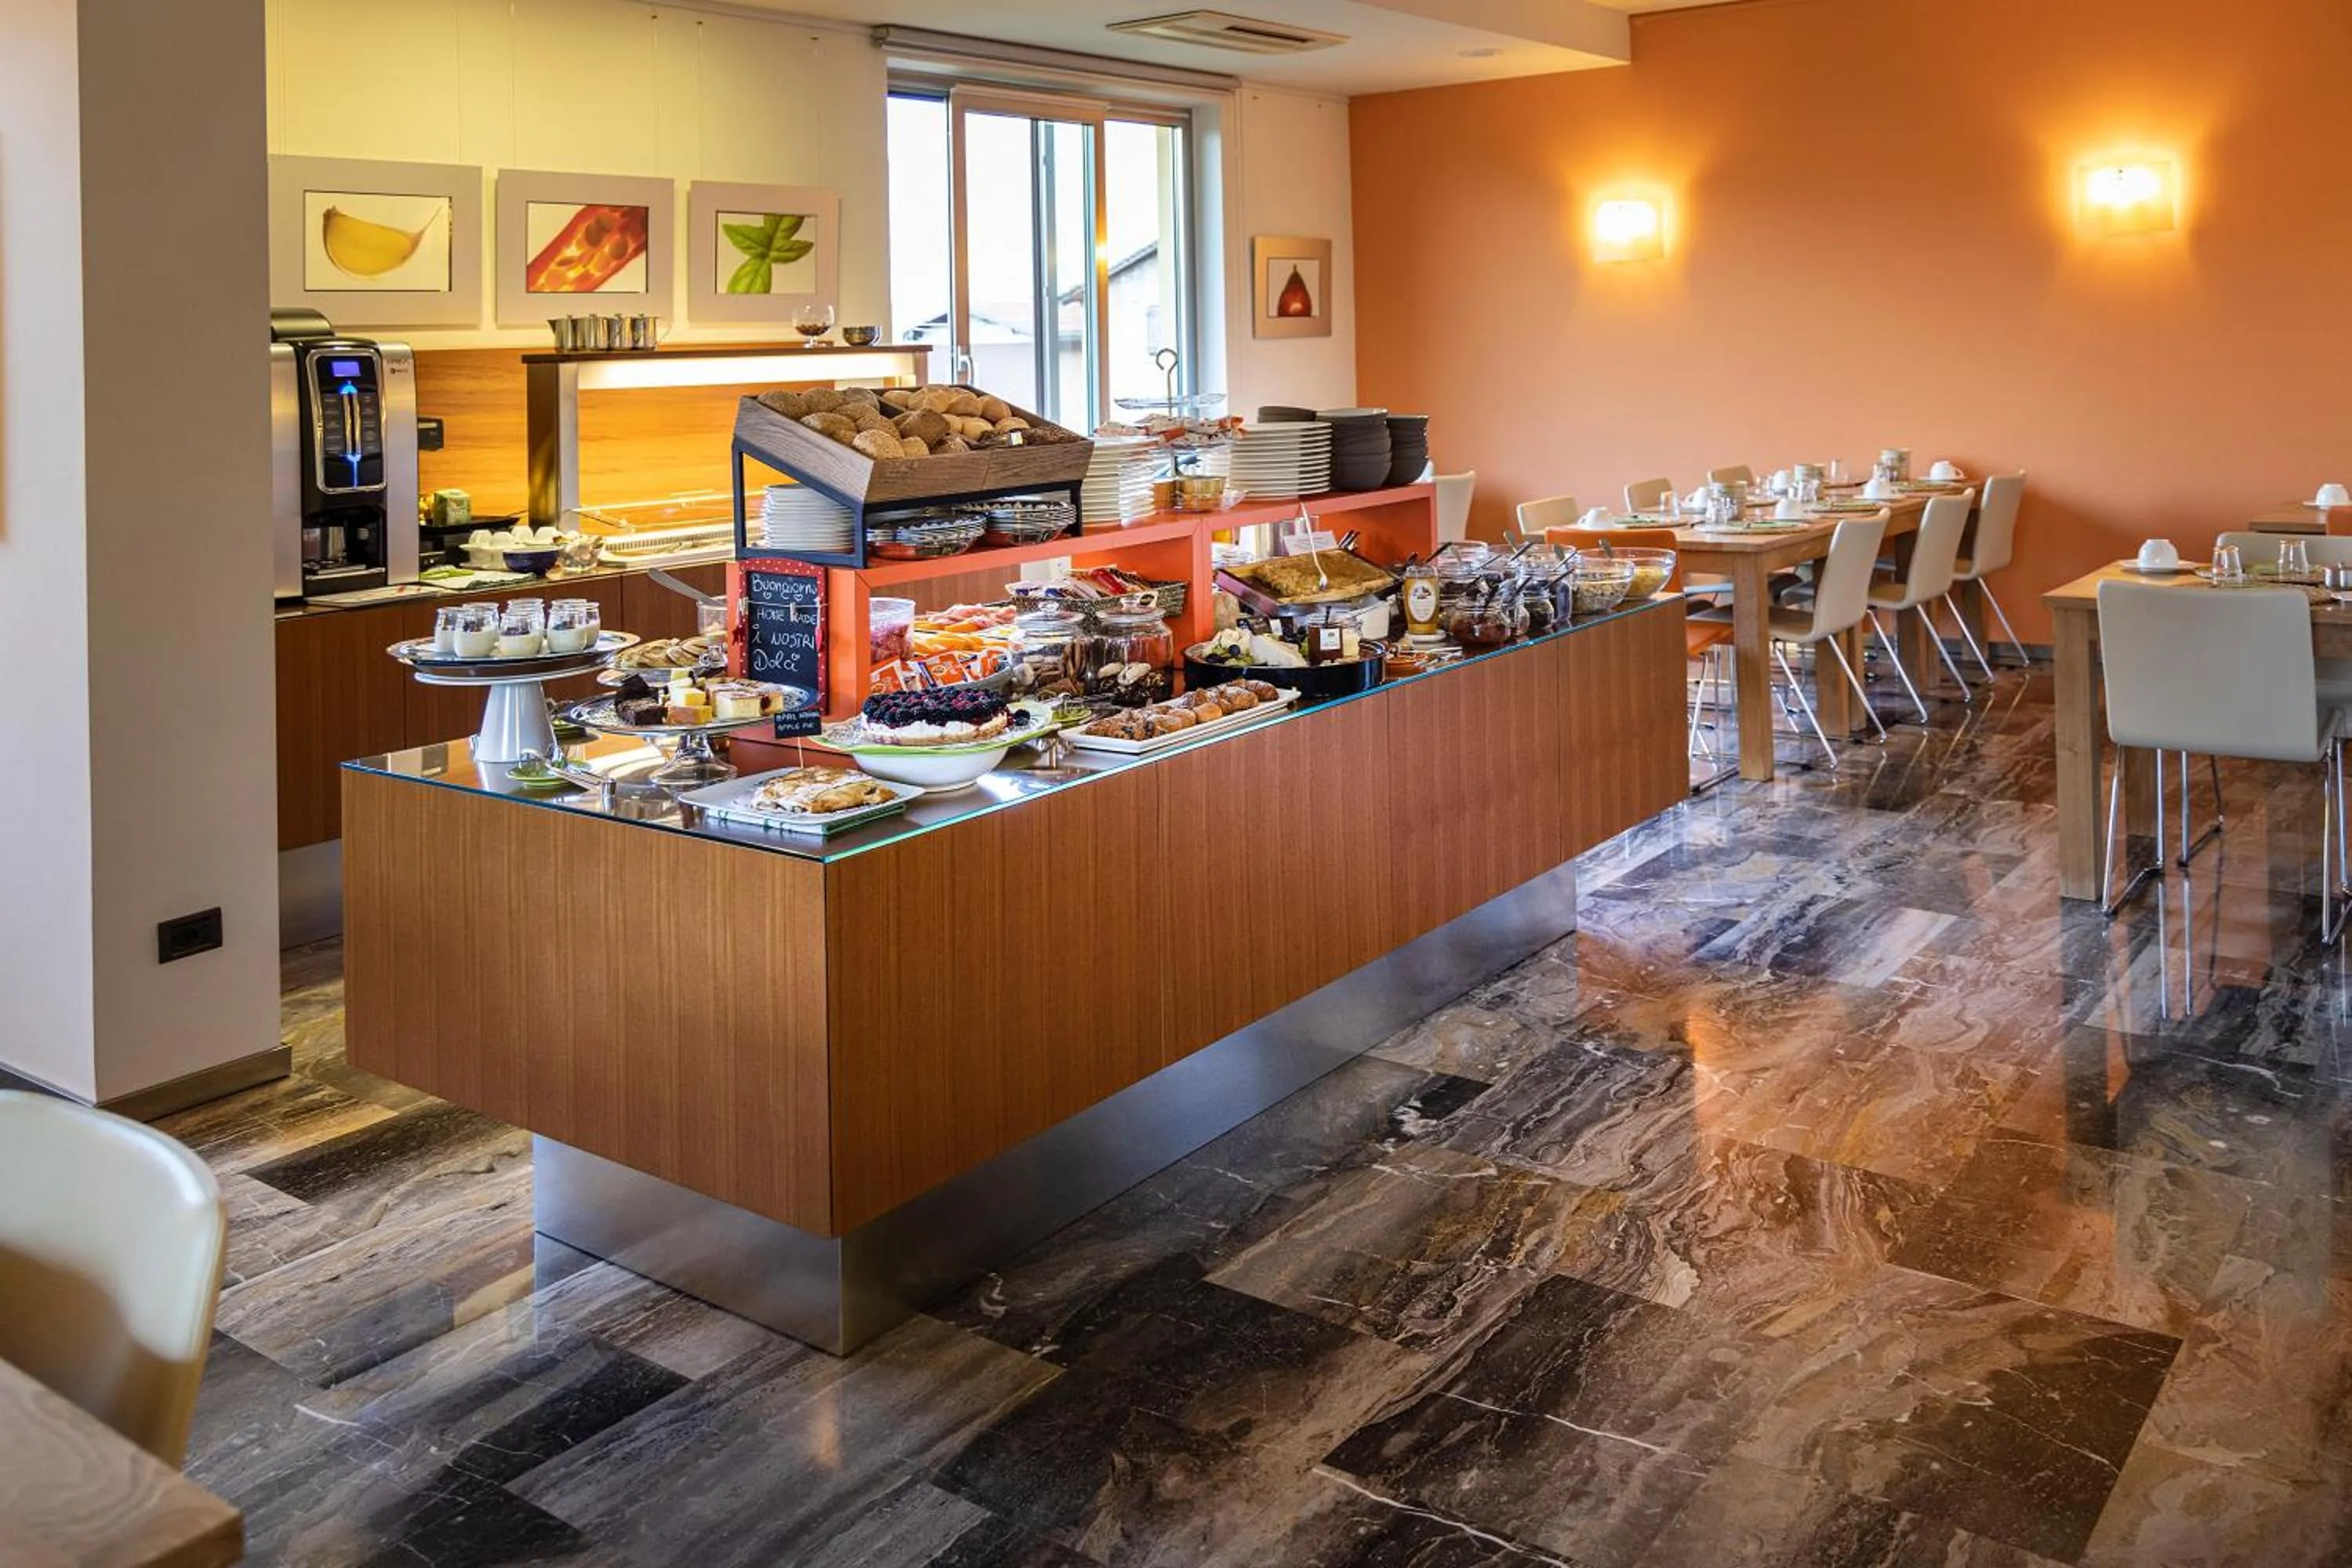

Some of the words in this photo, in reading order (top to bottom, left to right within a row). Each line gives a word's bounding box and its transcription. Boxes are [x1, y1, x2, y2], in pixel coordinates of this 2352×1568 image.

[752, 573, 818, 600] Buongiorno
[757, 604, 785, 622] HOME
[770, 632, 815, 650] NOSTRI
[753, 648, 800, 673] Dolci
